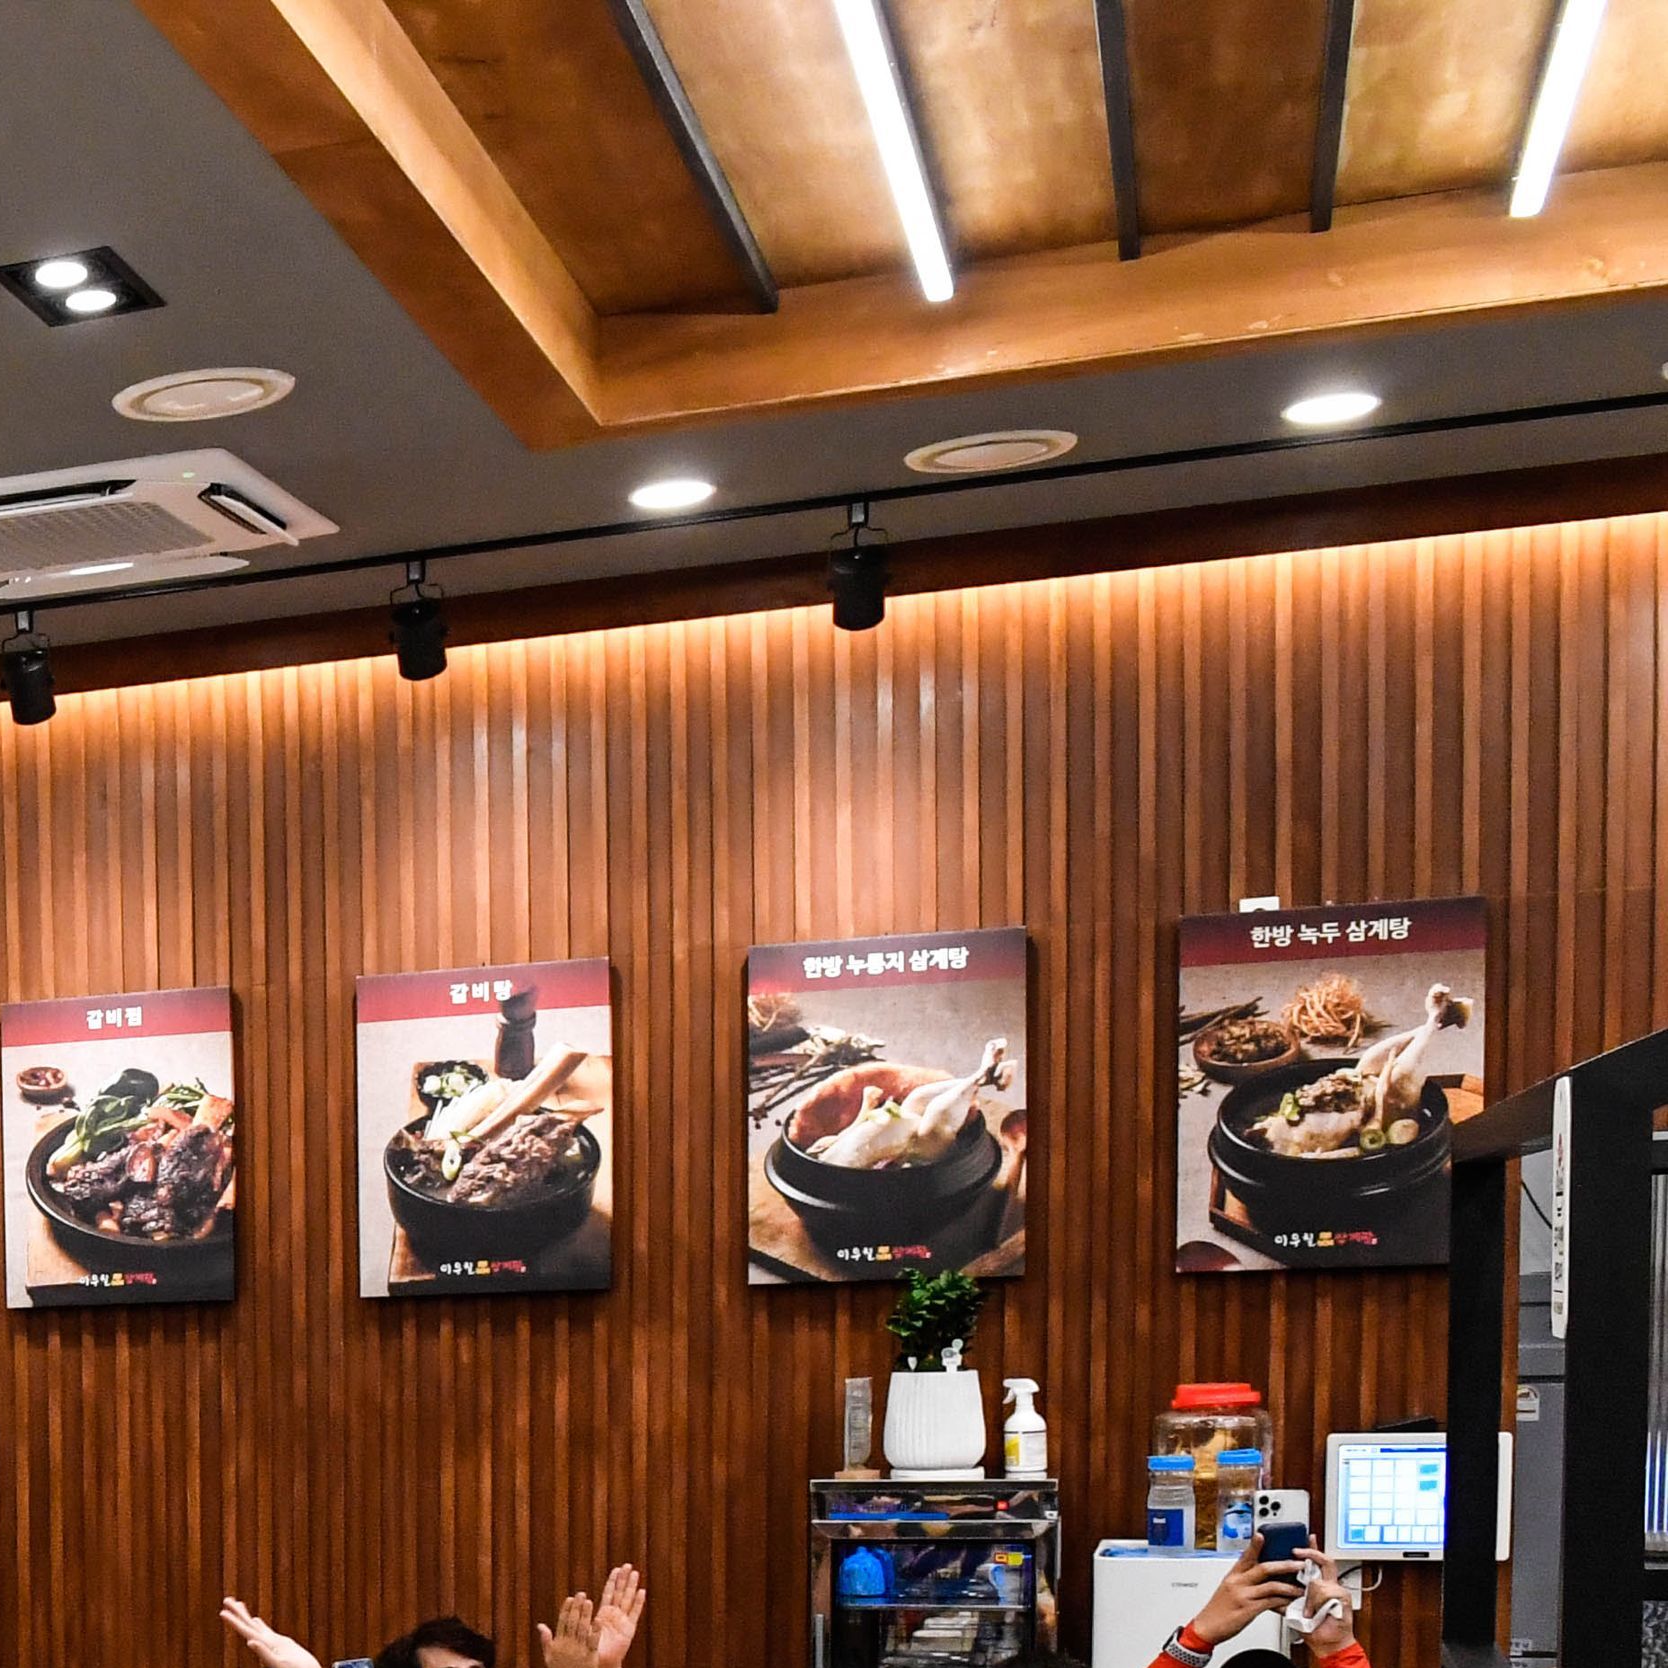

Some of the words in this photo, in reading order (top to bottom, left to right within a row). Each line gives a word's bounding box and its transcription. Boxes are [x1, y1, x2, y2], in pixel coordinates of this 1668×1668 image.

[1250, 925, 1294, 948] 한방
[1298, 922, 1341, 945] 녹두
[1346, 917, 1412, 942] 삼계탕
[803, 956, 842, 979] 한방
[909, 947, 969, 971] 삼계탕
[449, 979, 513, 1004] 갈비탕
[86, 1006, 142, 1029] 갈비찜
